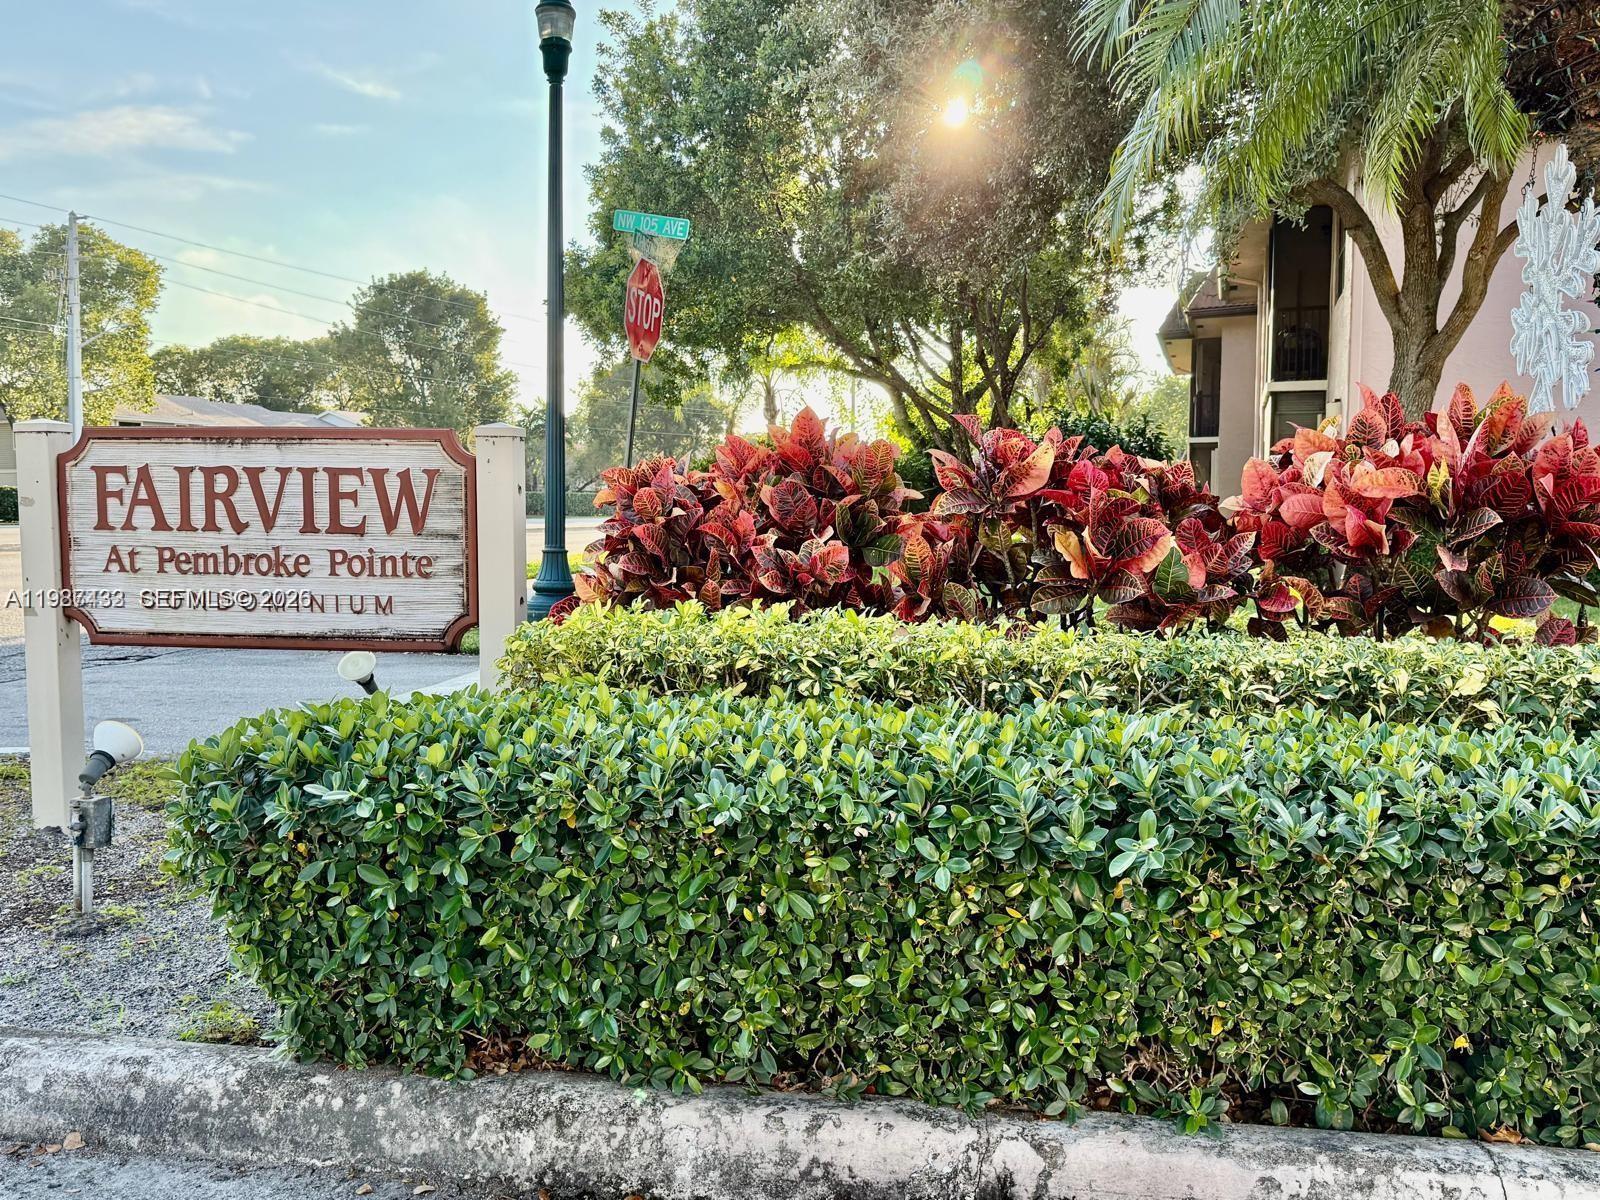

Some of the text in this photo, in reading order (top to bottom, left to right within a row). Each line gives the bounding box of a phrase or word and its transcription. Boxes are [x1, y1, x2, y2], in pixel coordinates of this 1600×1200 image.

[617, 213, 686, 237] NW 105 AVE
[627, 287, 661, 333] STOP
[90, 462, 441, 537] FAIRVIEW
[103, 544, 434, 579] At Pembroke Pointe
